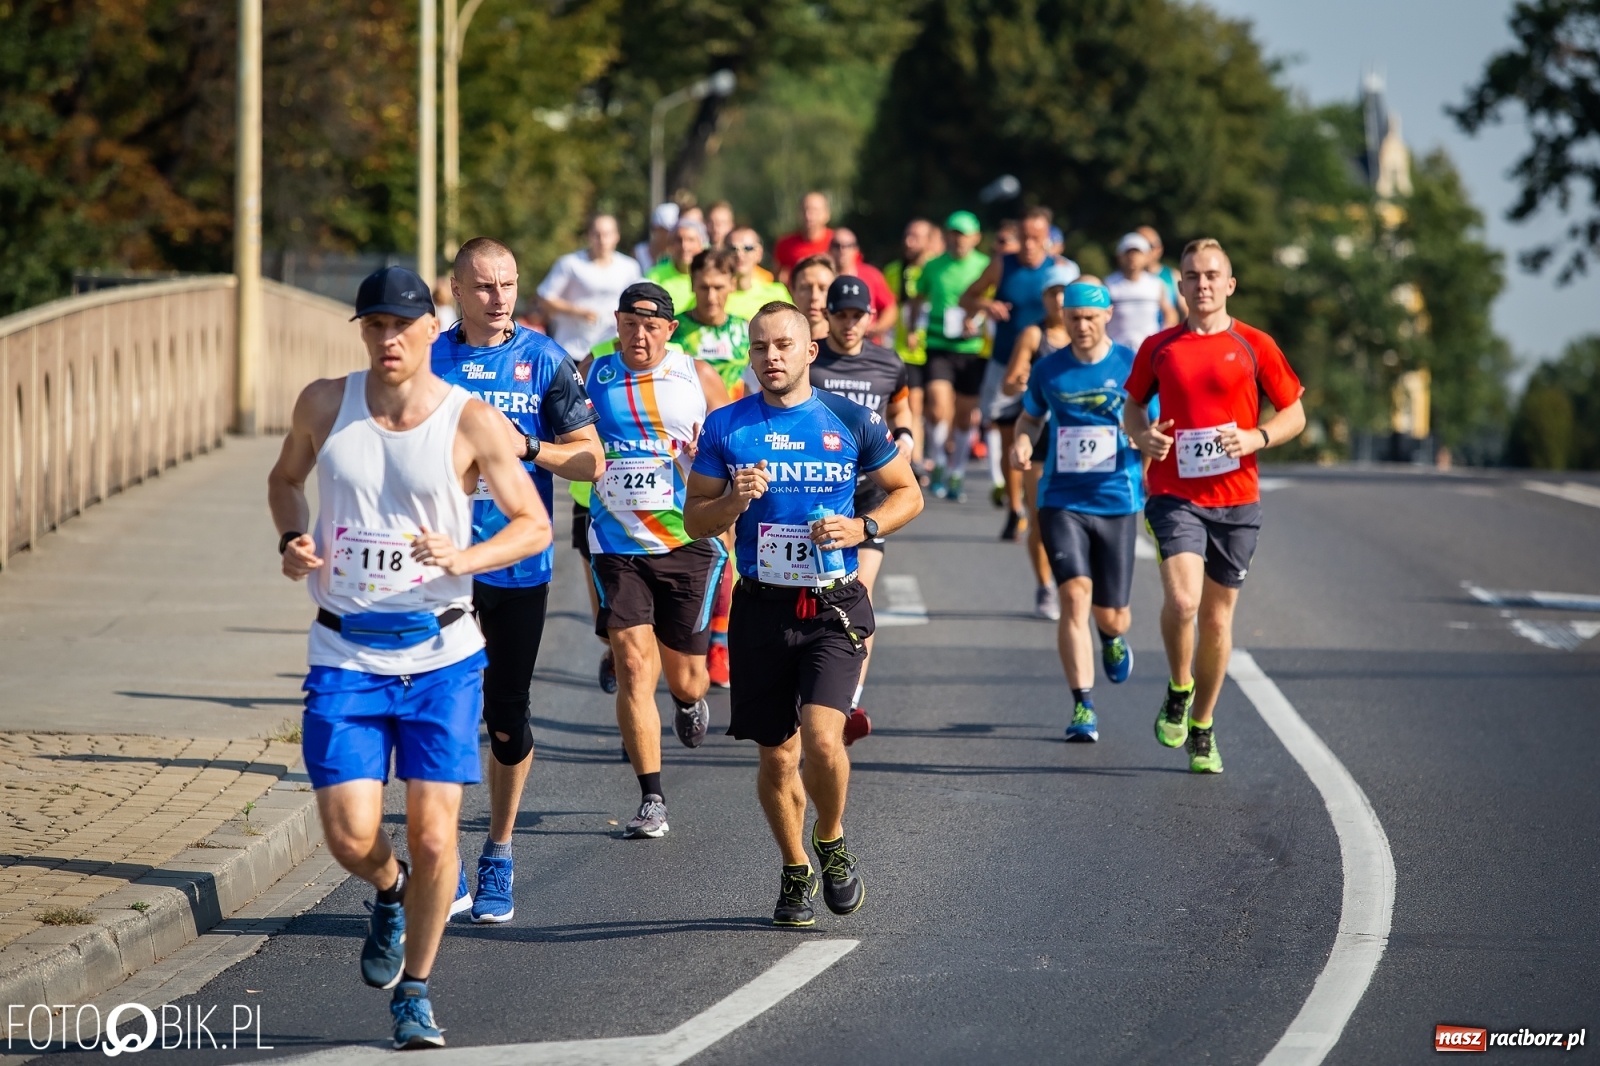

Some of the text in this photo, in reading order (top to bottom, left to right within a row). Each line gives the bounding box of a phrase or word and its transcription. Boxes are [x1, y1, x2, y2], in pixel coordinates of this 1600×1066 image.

[1079, 439, 1097, 454] 59
[1194, 441, 1224, 458] 298
[623, 472, 656, 489] 224
[361, 547, 403, 572] 118
[784, 541, 814, 562] 13
